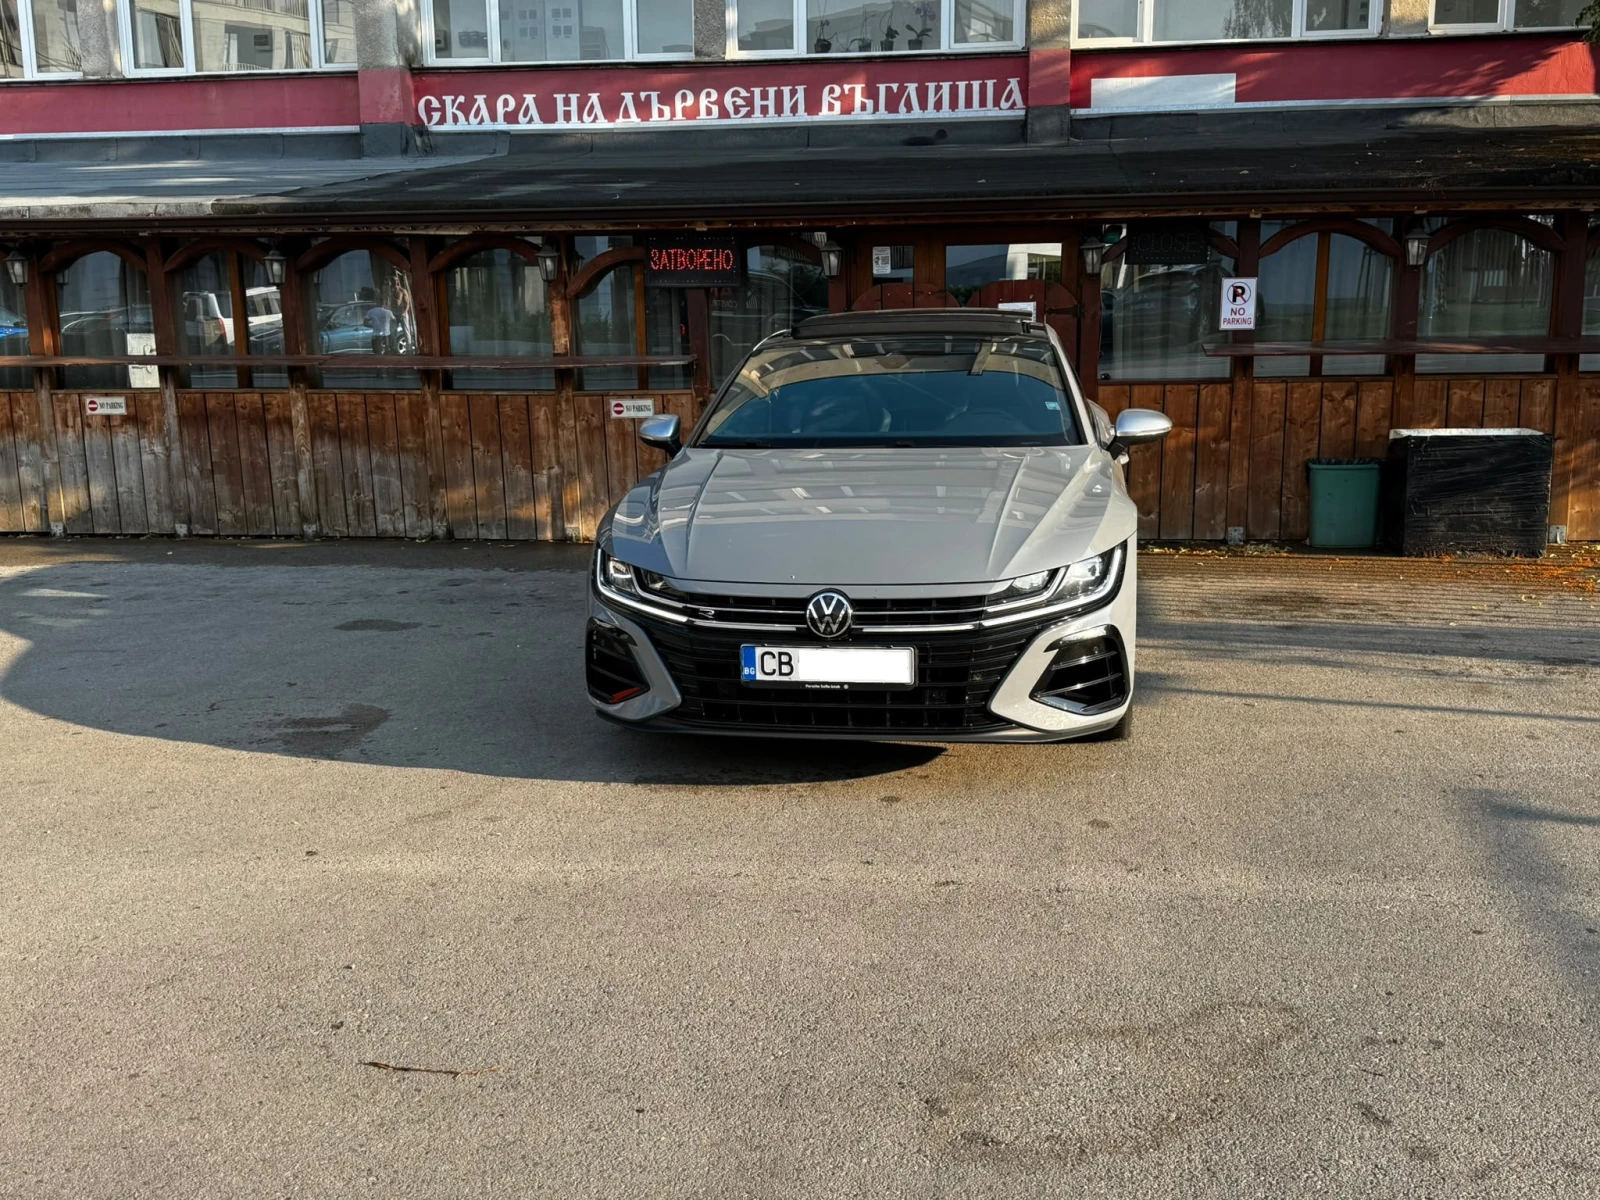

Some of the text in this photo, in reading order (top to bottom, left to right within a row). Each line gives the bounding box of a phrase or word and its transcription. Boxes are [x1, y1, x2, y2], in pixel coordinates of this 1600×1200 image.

[417, 94, 543, 126] СКАРА
[553, 92, 608, 123] НА
[615, 85, 808, 123] ДЪРВЕНИ
[650, 249, 733, 270] ЗАТВОРЕНО
[1230, 307, 1246, 316] NO
[1223, 317, 1252, 325] PARKING
[633, 404, 651, 412] PARKING
[760, 651, 794, 676] CB
[744, 667, 755, 675] BG
